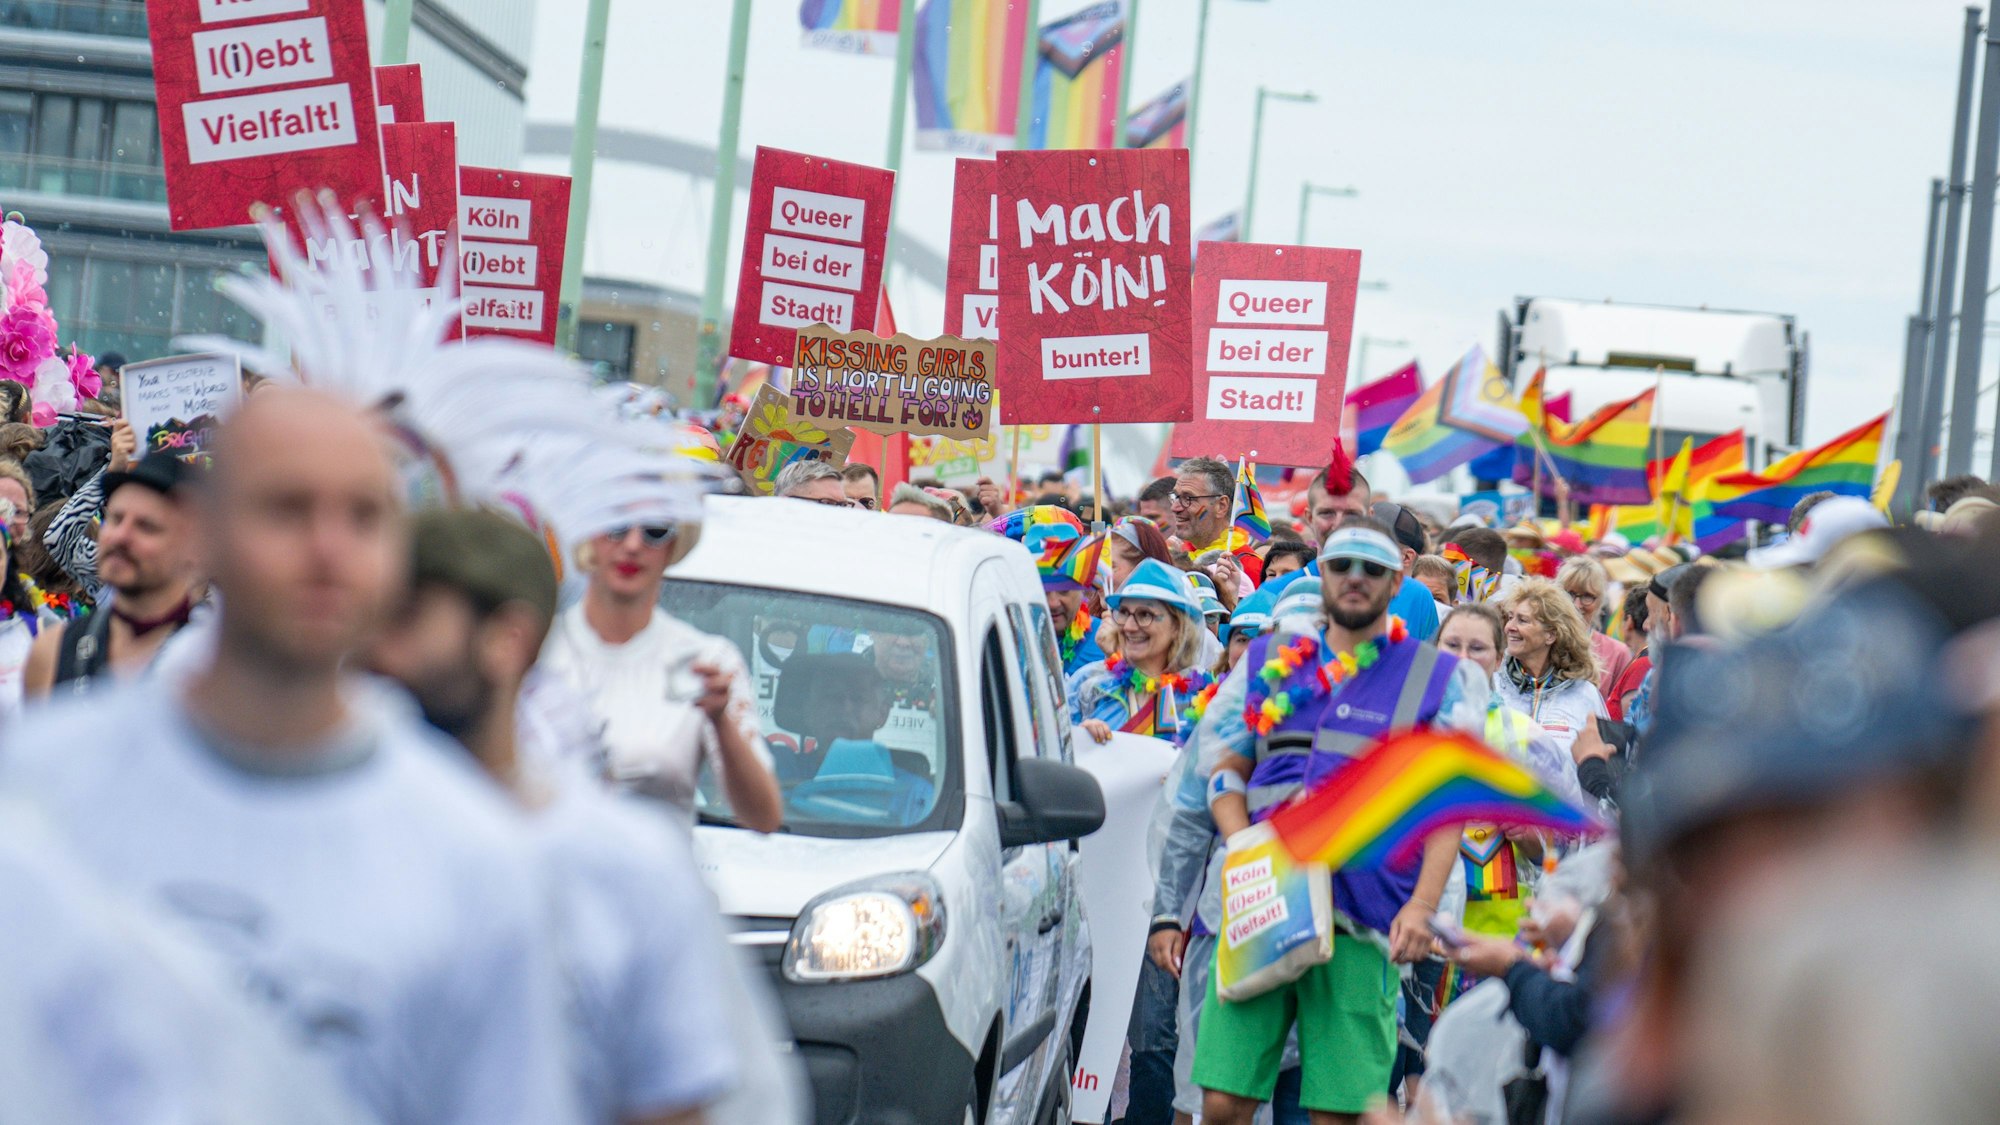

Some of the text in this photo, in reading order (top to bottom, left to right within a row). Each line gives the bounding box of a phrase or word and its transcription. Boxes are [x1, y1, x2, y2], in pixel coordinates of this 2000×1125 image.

[208, 37, 315, 79] l(i)ebt
[201, 101, 340, 145] Vielfalt!
[468, 206, 520, 229] Köln
[781, 200, 853, 229] Queer
[462, 251, 526, 275] (i)ebt
[772, 246, 852, 278] bei der
[465, 298, 533, 320] elfalt!
[771, 295, 843, 325] Stadt!
[1228, 291, 1313, 317] Queer
[798, 335, 986, 380] KISSING GIRLS
[1052, 346, 1140, 369] bunter!
[1219, 340, 1314, 363] bei der
[797, 364, 990, 405] IS WORTH GOING
[791, 388, 958, 428] TO HELL FOR!
[1219, 388, 1303, 411] Stadt!
